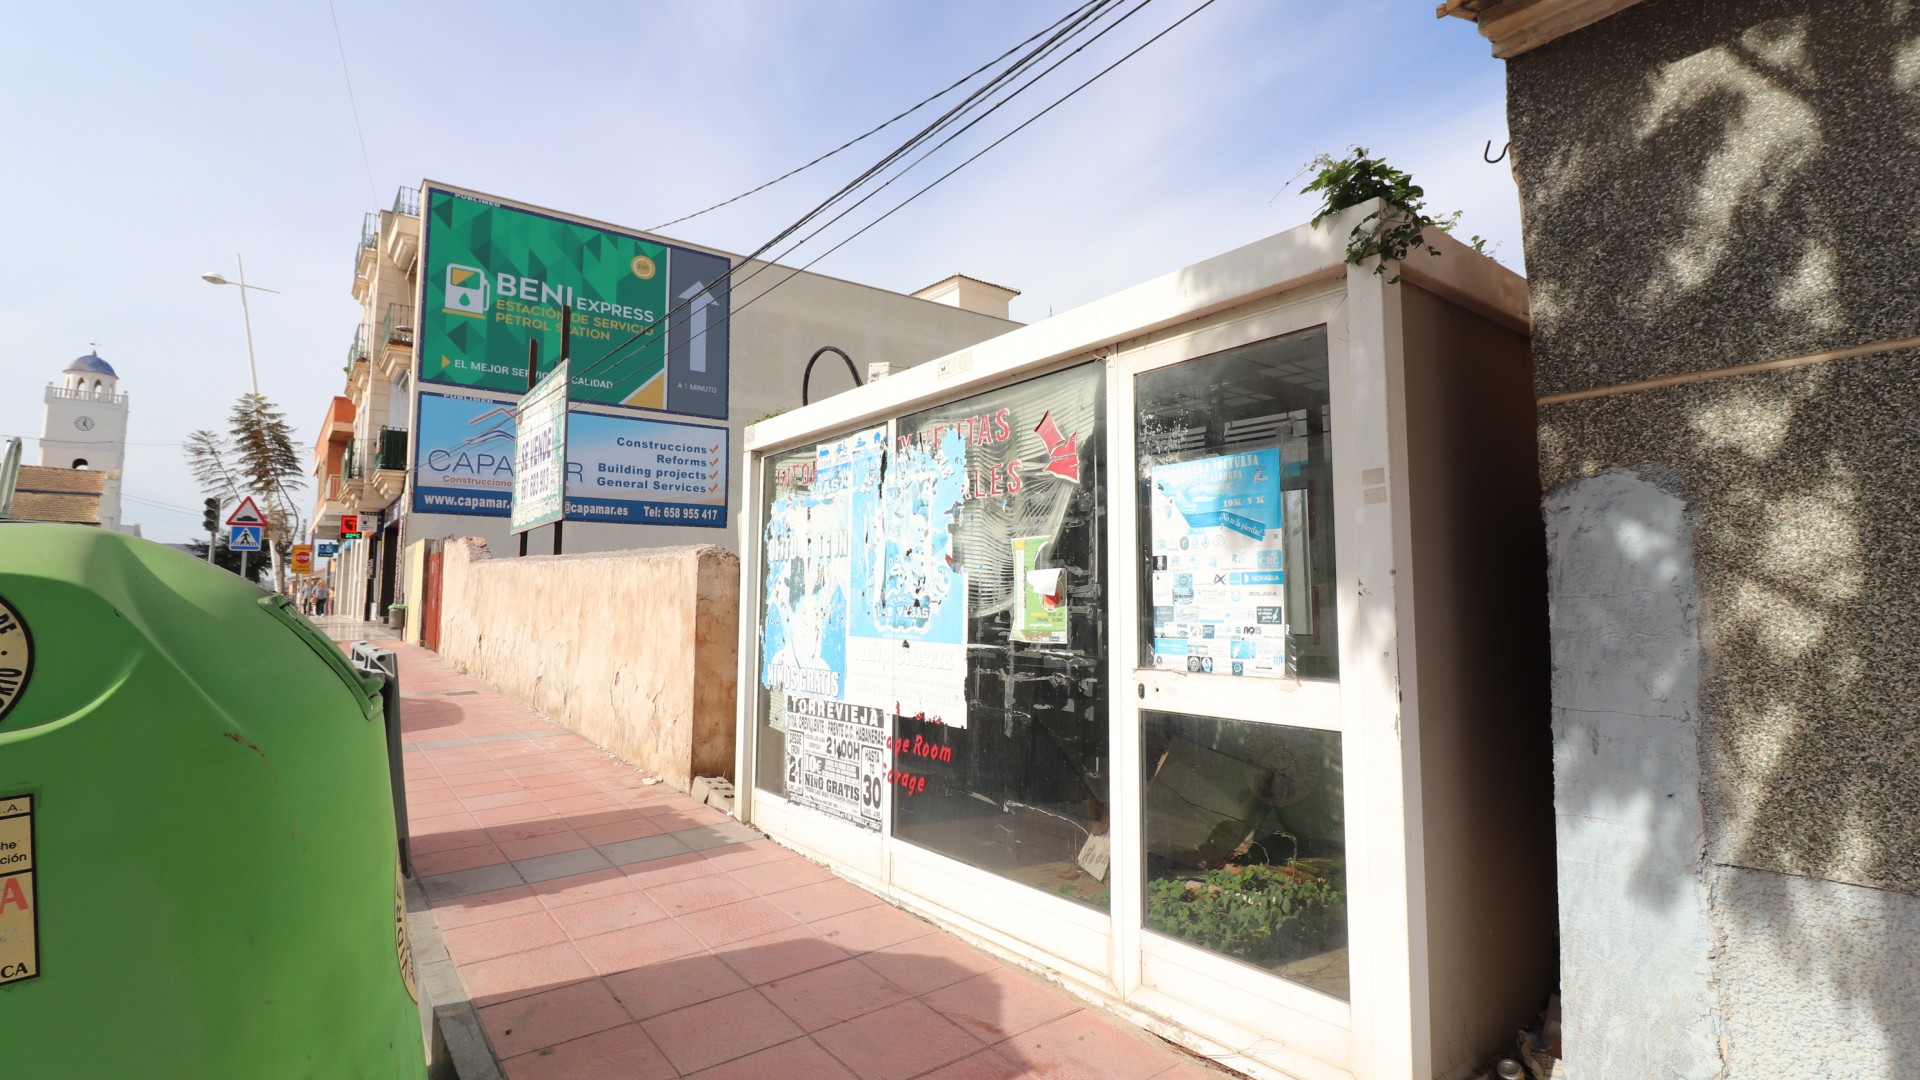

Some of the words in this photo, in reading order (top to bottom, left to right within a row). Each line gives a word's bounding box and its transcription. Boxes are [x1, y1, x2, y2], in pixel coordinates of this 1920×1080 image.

[497, 272, 573, 307] BENI
[576, 297, 654, 323] EXPRESS
[496, 312, 551, 331] PETROL
[555, 323, 611, 341] SATION
[571, 312, 589, 325] DE
[593, 315, 654, 336] SERVICIO
[454, 359, 468, 369] EL
[470, 361, 509, 376] MEJOR
[571, 377, 613, 389] CALIDAD
[690, 384, 717, 394] MINUTO
[521, 441, 529, 472] SE
[530, 427, 552, 468] VENDE
[616, 437, 707, 454] Construccions
[598, 463, 651, 478] Building
[655, 468, 707, 480] projects
[656, 454, 707, 467] Reforms
[442, 474, 513, 487] Construccione
[596, 477, 648, 490] General
[653, 481, 706, 493] Services
[644, 506, 661, 518] Tel:
[664, 507, 680, 519] 658
[683, 508, 699, 520] 955
[702, 509, 718, 521] 417
[799, 666, 839, 698] GRATIS
[791, 697, 880, 728] TORREVIEJA
[865, 748, 880, 764] HASTA
[913, 734, 952, 763] Room
[805, 754, 822, 775] 10€
[826, 778, 860, 802] GRATIS
[862, 774, 882, 810] 30
